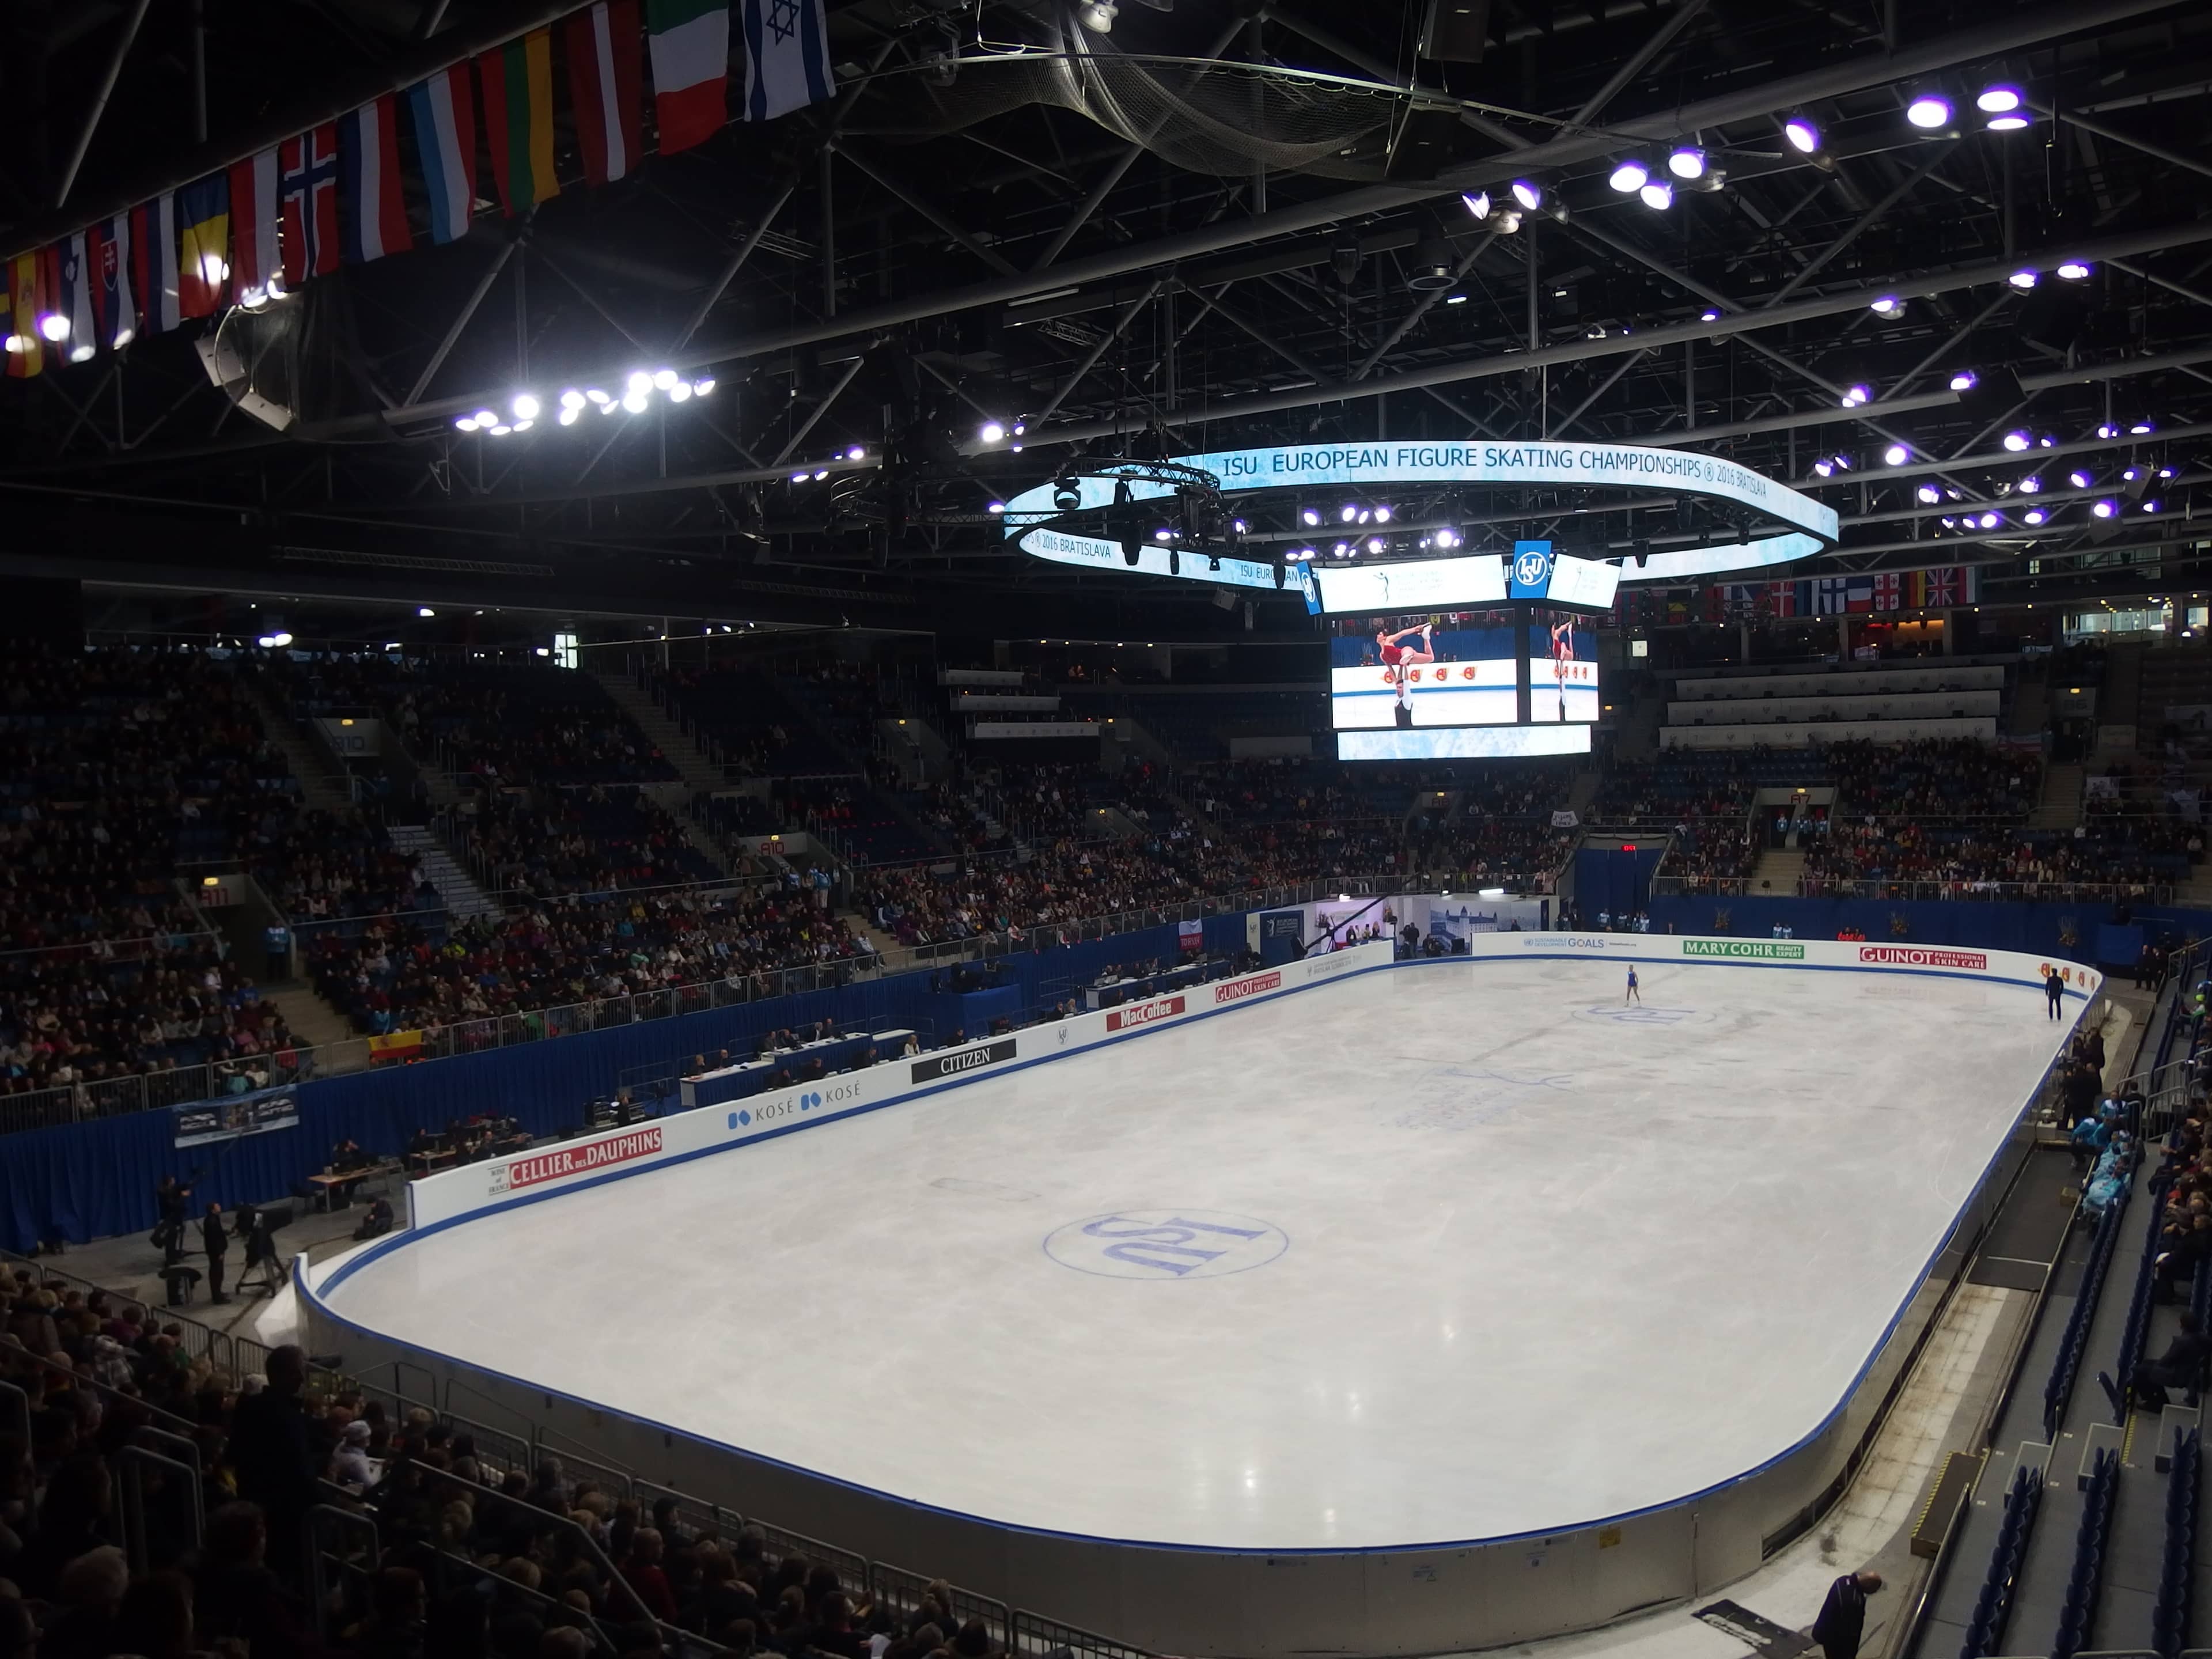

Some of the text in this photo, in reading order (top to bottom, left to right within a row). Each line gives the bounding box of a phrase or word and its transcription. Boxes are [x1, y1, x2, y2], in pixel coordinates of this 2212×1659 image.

[1224, 457, 1257, 476] ISU
[1274, 449, 1388, 472] EUROPEAN
[1398, 448, 1476, 467] FIGURE
[1485, 449, 1573, 468] SKATING
[1580, 451, 1700, 478] CHAMPIONSHIPS
[1718, 465, 1734, 487] 2016
[1736, 470, 1766, 498] BRATISLAVA
[1043, 534, 1058, 550] 2016
[1060, 539, 1111, 559] BRATISLAVA
[1241, 565, 1252, 577] ISU
[1519, 556, 1544, 583] ISU
[761, 842, 784, 855] A10
[1568, 938, 1604, 948] GOALS
[1686, 942, 1772, 956] MARY COHR
[1861, 948, 1933, 965] GUINOT
[1934, 952, 1984, 961] PROFESSIONAL
[1934, 958, 1985, 968] SKIN CARE
[1216, 980, 1253, 1002] GUINOT
[1254, 983, 1266, 991] SKIN
[1120, 1002, 1172, 1027] MacCoffee
[941, 1048, 990, 1073] CITIZEN
[826, 1080, 861, 1103] KOSÉ
[756, 1097, 793, 1121] KOSÉ
[511, 1153, 573, 1184] CELLIER
[588, 1130, 661, 1165] DAUPHINS
